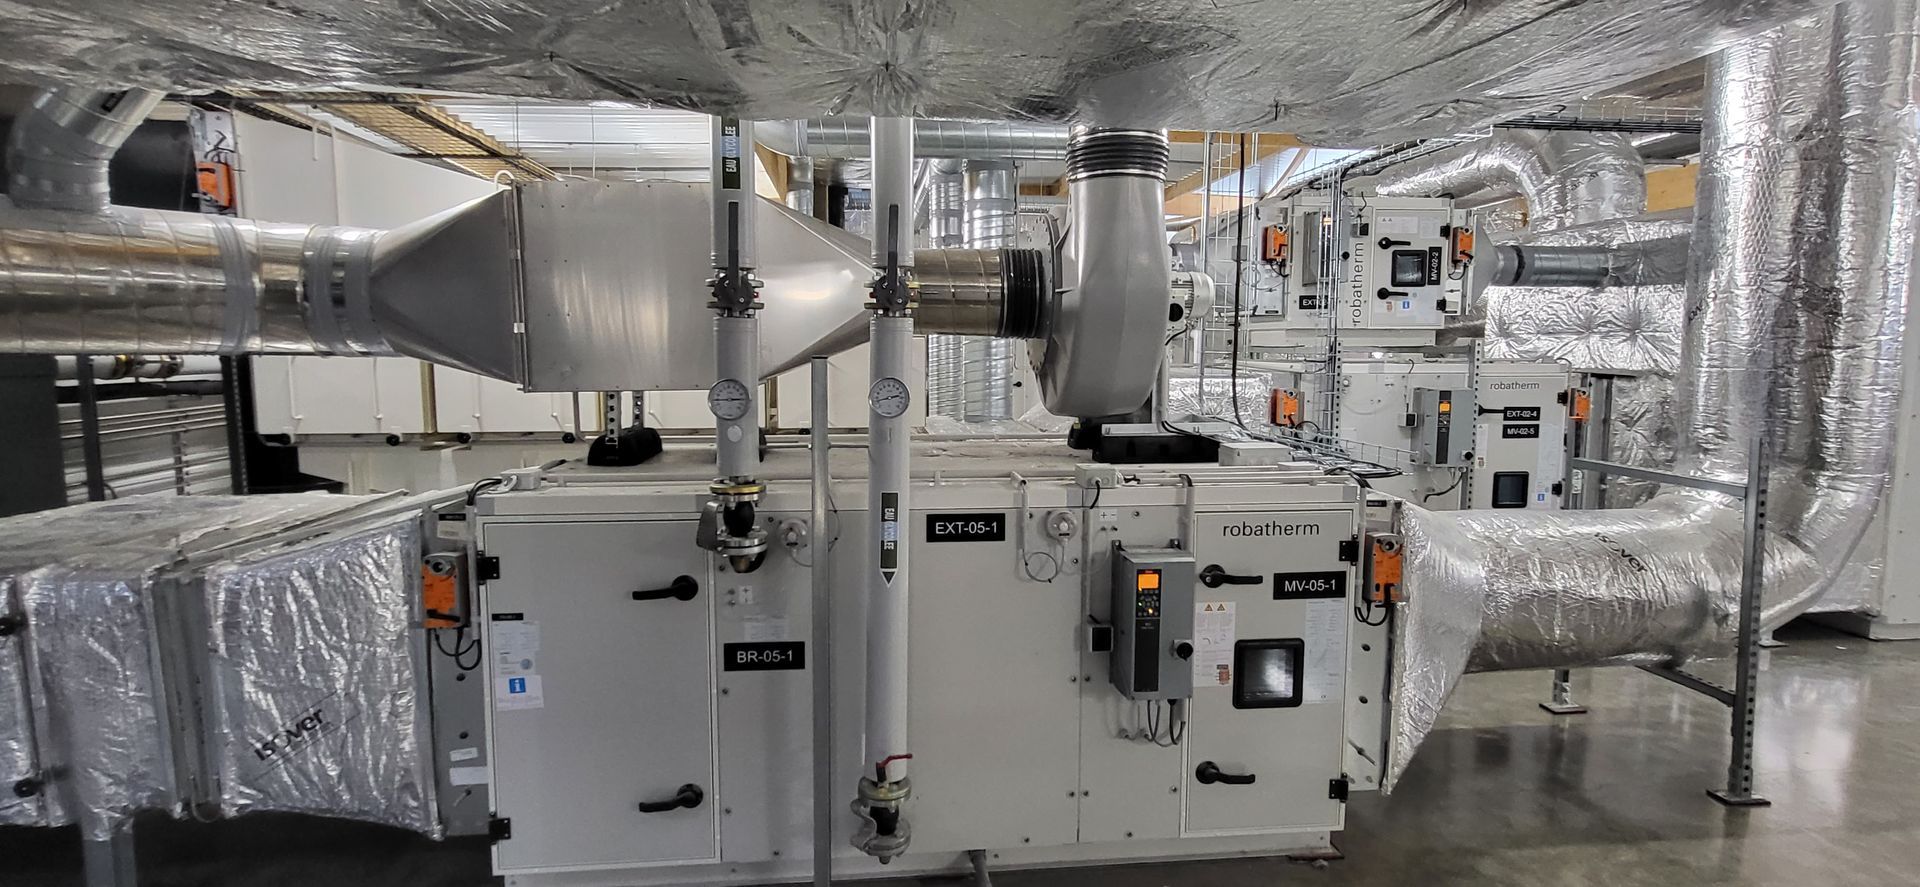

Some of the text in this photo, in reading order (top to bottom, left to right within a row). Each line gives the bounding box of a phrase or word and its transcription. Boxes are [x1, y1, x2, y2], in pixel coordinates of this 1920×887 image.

[725, 160, 737, 173] EAU
[1430, 251, 1439, 280] MV-02-2
[1350, 242, 1364, 324] robatherm
[1490, 381, 1540, 390] robatherm
[1506, 410, 1538, 418] EXT-02-4
[1507, 427, 1535, 435] MV-02-5
[884, 507, 895, 520] EAU
[935, 521, 997, 535] EXT-05-1
[1223, 520, 1320, 537] robatherm
[1284, 579, 1336, 592] MV-05-1
[737, 649, 793, 663] BR-05-1
[254, 708, 323, 761] isover
